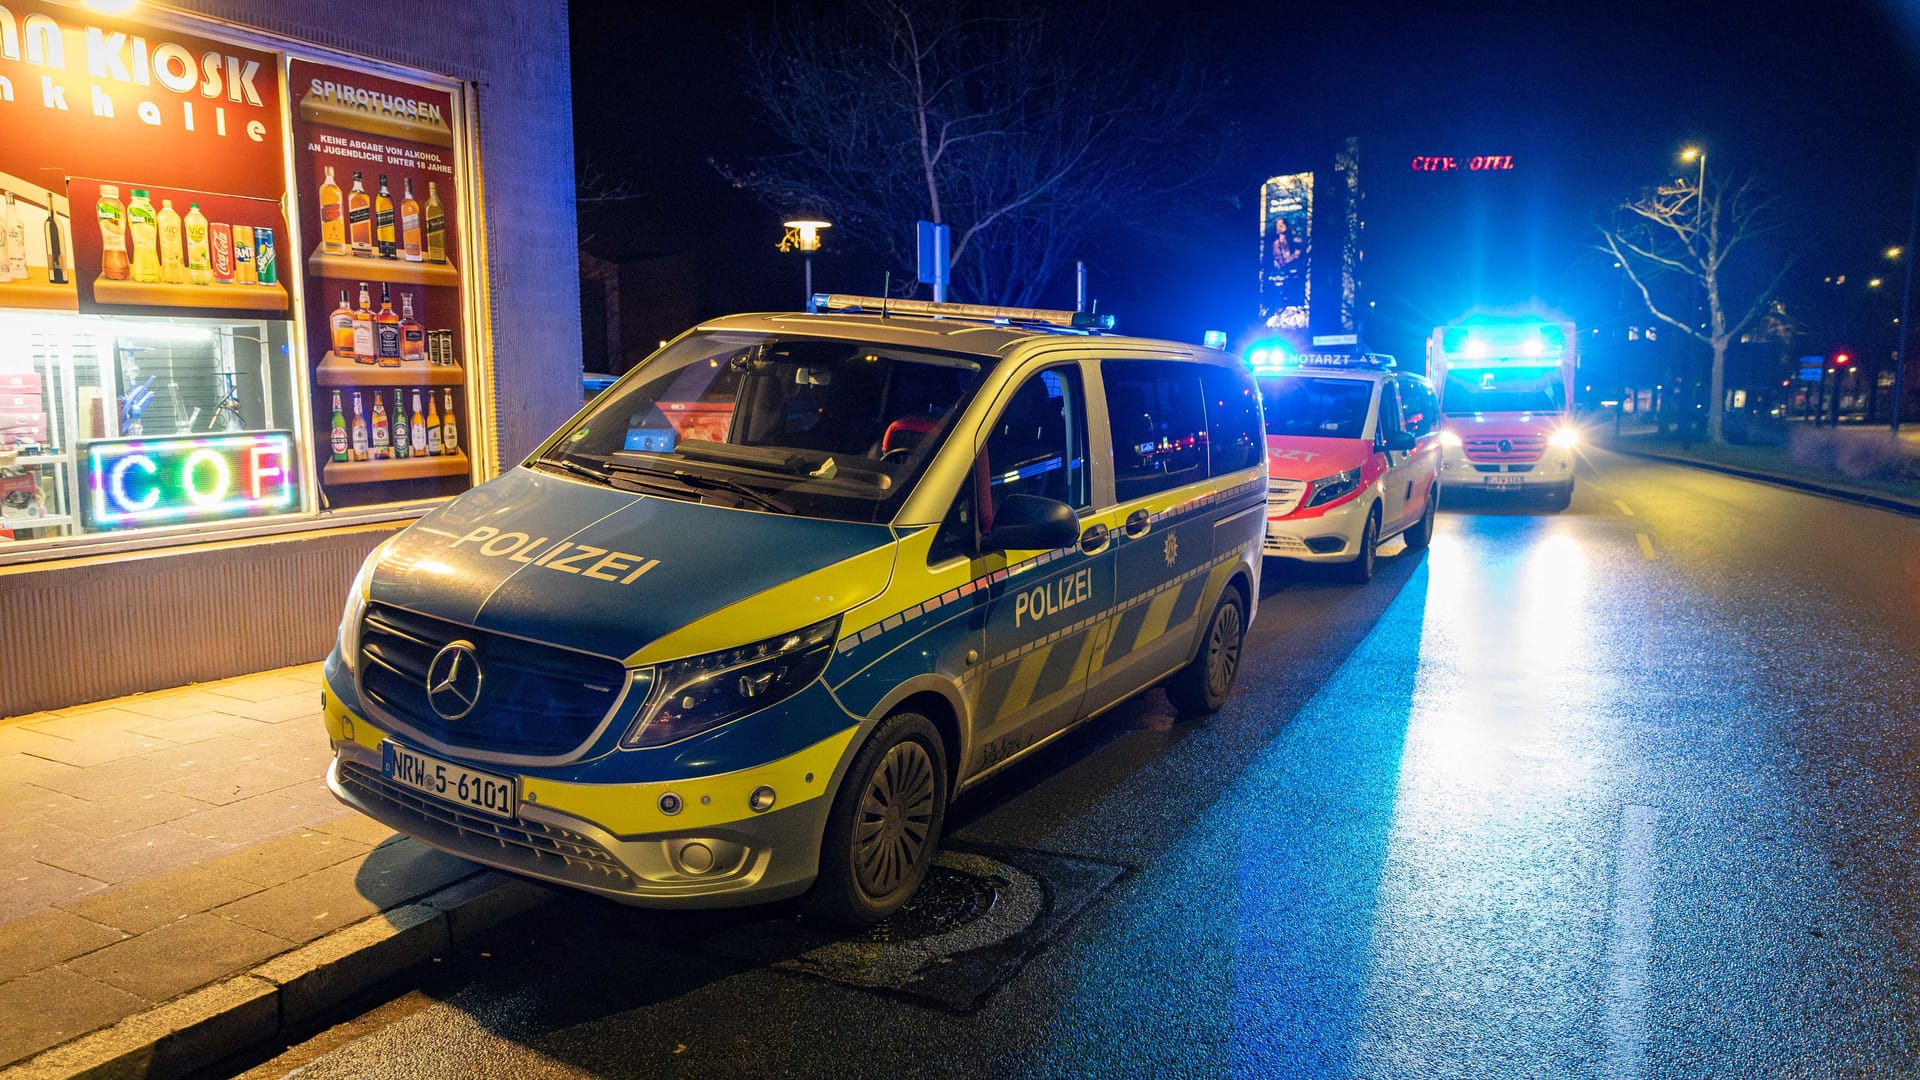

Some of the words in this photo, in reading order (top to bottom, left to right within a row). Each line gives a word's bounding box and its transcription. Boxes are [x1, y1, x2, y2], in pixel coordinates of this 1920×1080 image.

[86, 26, 263, 107] KIOSK
[311, 78, 441, 120] SPIROTUOSEN
[308, 143, 321, 152] AN
[323, 145, 383, 162] JUGENDLICHE
[387, 156, 415, 168] UNTER
[417, 161, 426, 169] 18
[427, 162, 453, 174] JAHRE
[320, 134, 347, 146] KEINE
[349, 140, 384, 153] ABGABE
[386, 146, 403, 156] VON
[404, 150, 441, 163] ALKOHOL
[1288, 353, 1351, 366] NOTARZT
[448, 525, 661, 585] POLIZEI
[1015, 567, 1092, 628] POLIZEI
[392, 749, 425, 787] NRW
[435, 764, 510, 814] 5-6101
